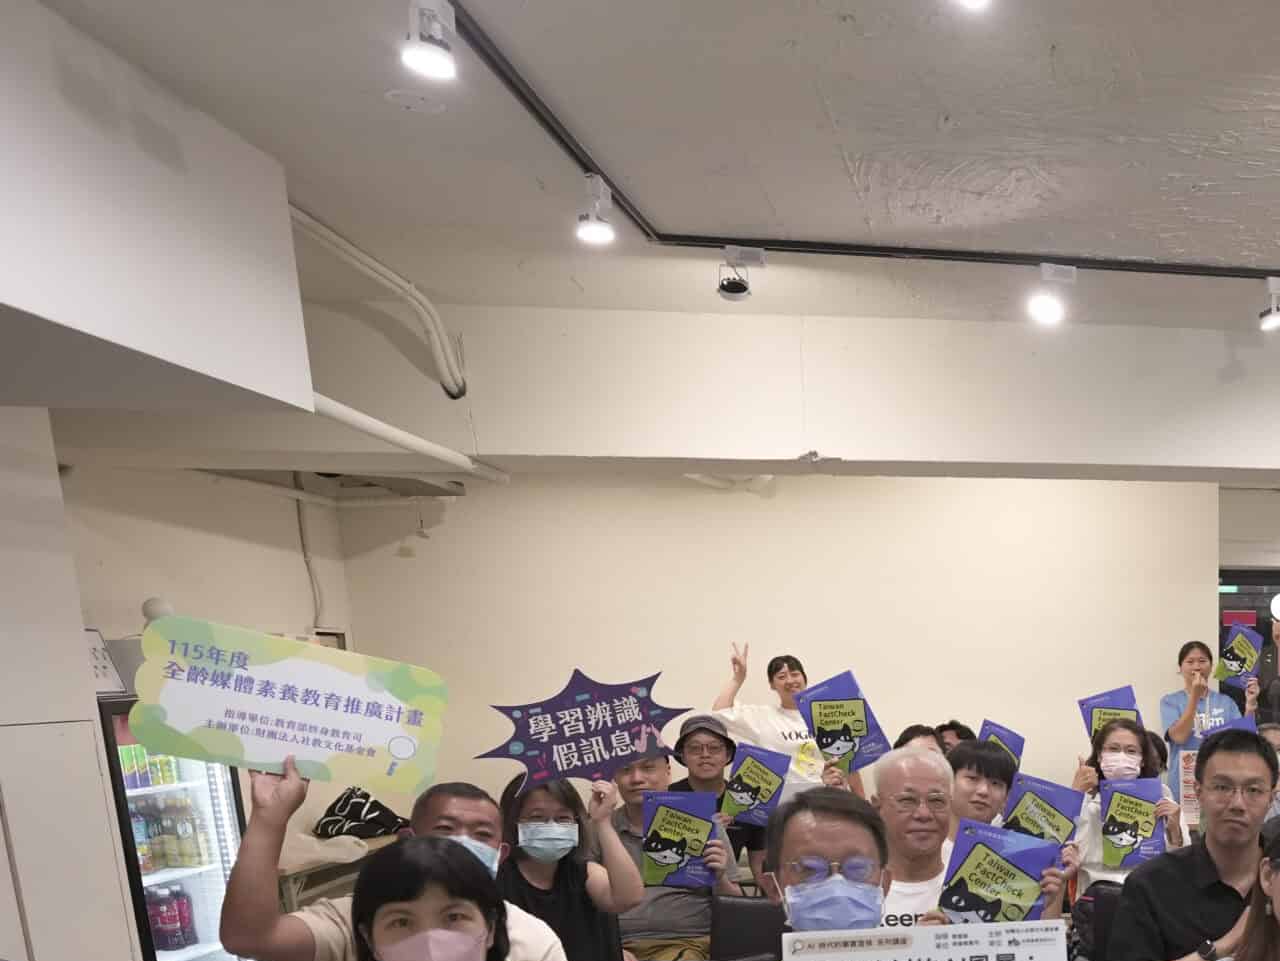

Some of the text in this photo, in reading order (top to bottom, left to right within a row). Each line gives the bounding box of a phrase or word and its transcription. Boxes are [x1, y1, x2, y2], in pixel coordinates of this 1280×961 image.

[167, 639, 249, 672] 115年度
[163, 660, 425, 728] 全齡媒體素養教育推廣計畫
[528, 696, 643, 743] 學習辨識
[982, 852, 1017, 881] Taiwan
